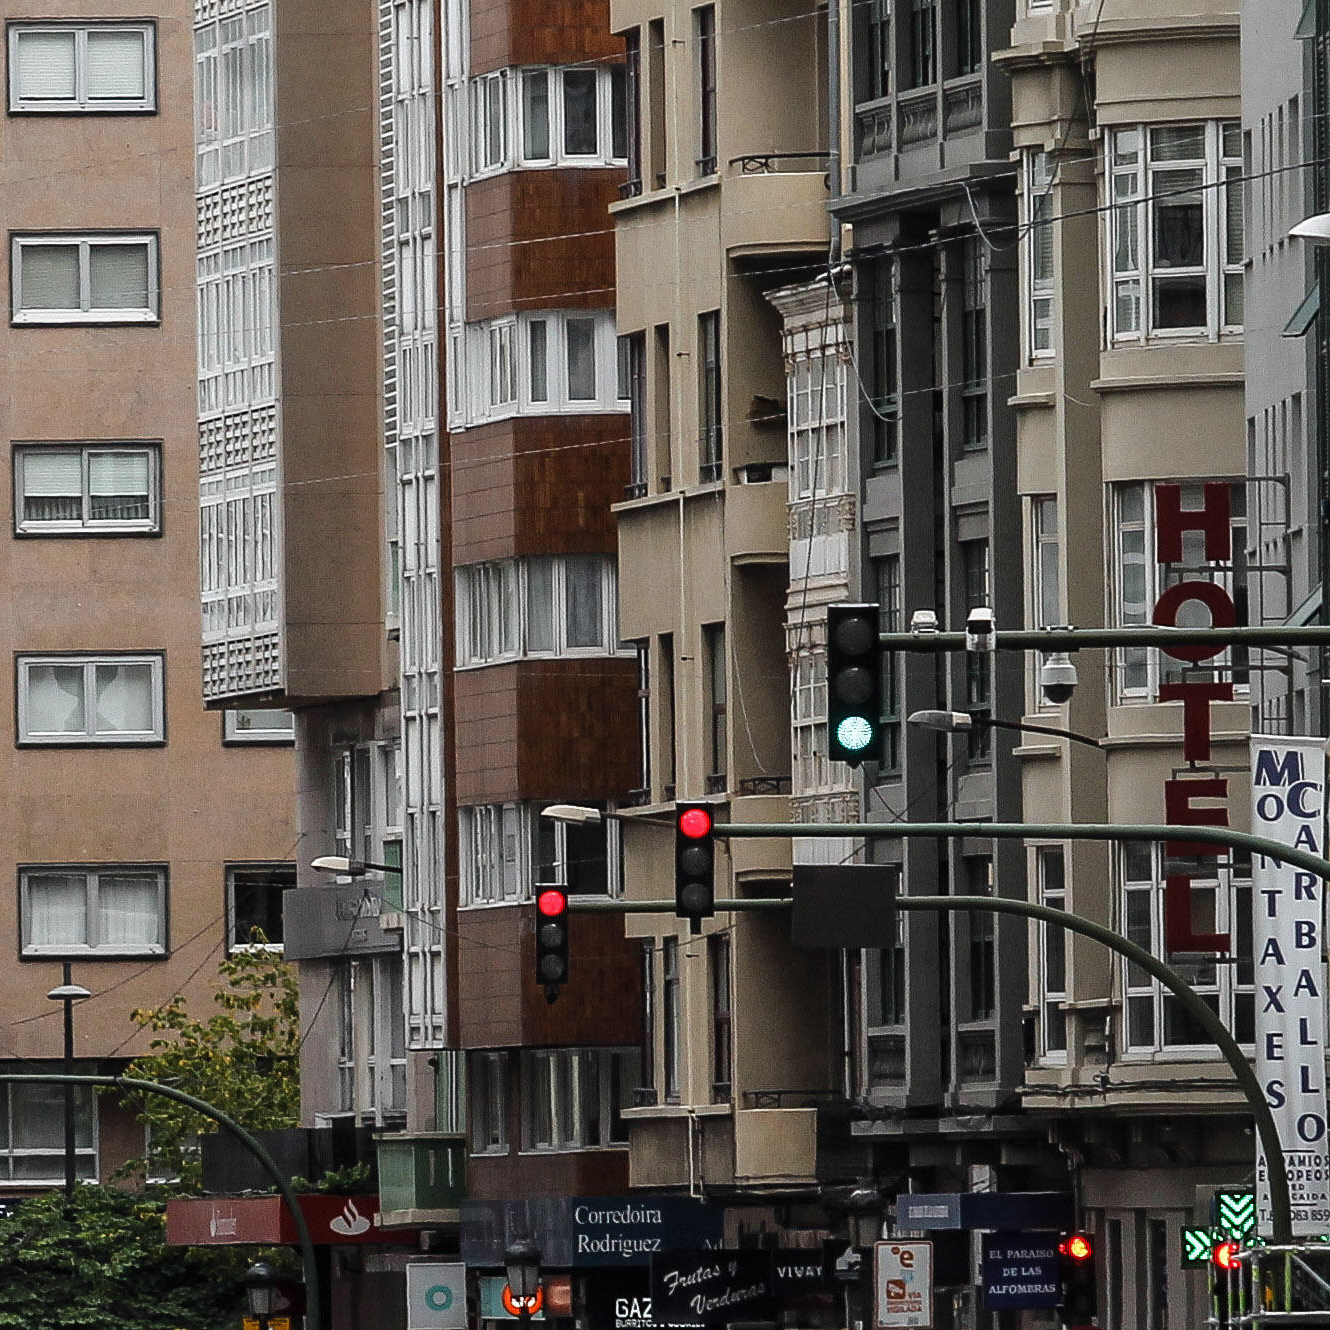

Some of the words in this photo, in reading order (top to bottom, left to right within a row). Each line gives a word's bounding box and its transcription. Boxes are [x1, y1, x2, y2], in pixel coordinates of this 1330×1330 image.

[1153, 482, 1236, 952] HOTEL
[1285, 781, 1326, 1143] CARBALLO
[1258, 1155, 1330, 1168] AAMIOS
[1259, 1169, 1330, 1182] EOPEOS
[575, 1204, 662, 1225] Corredoira
[1311, 1208, 1330, 1222] 859
[989, 1250, 1003, 1259] EL
[1007, 1249, 1054, 1259] PARAISO
[1002, 1267, 1017, 1277] DE
[1021, 1267, 1042, 1276] LAS
[663, 1263, 721, 1296] Frutas
[988, 1284, 1056, 1295] ALFOMBRAS
[689, 1281, 765, 1315] Verduras
